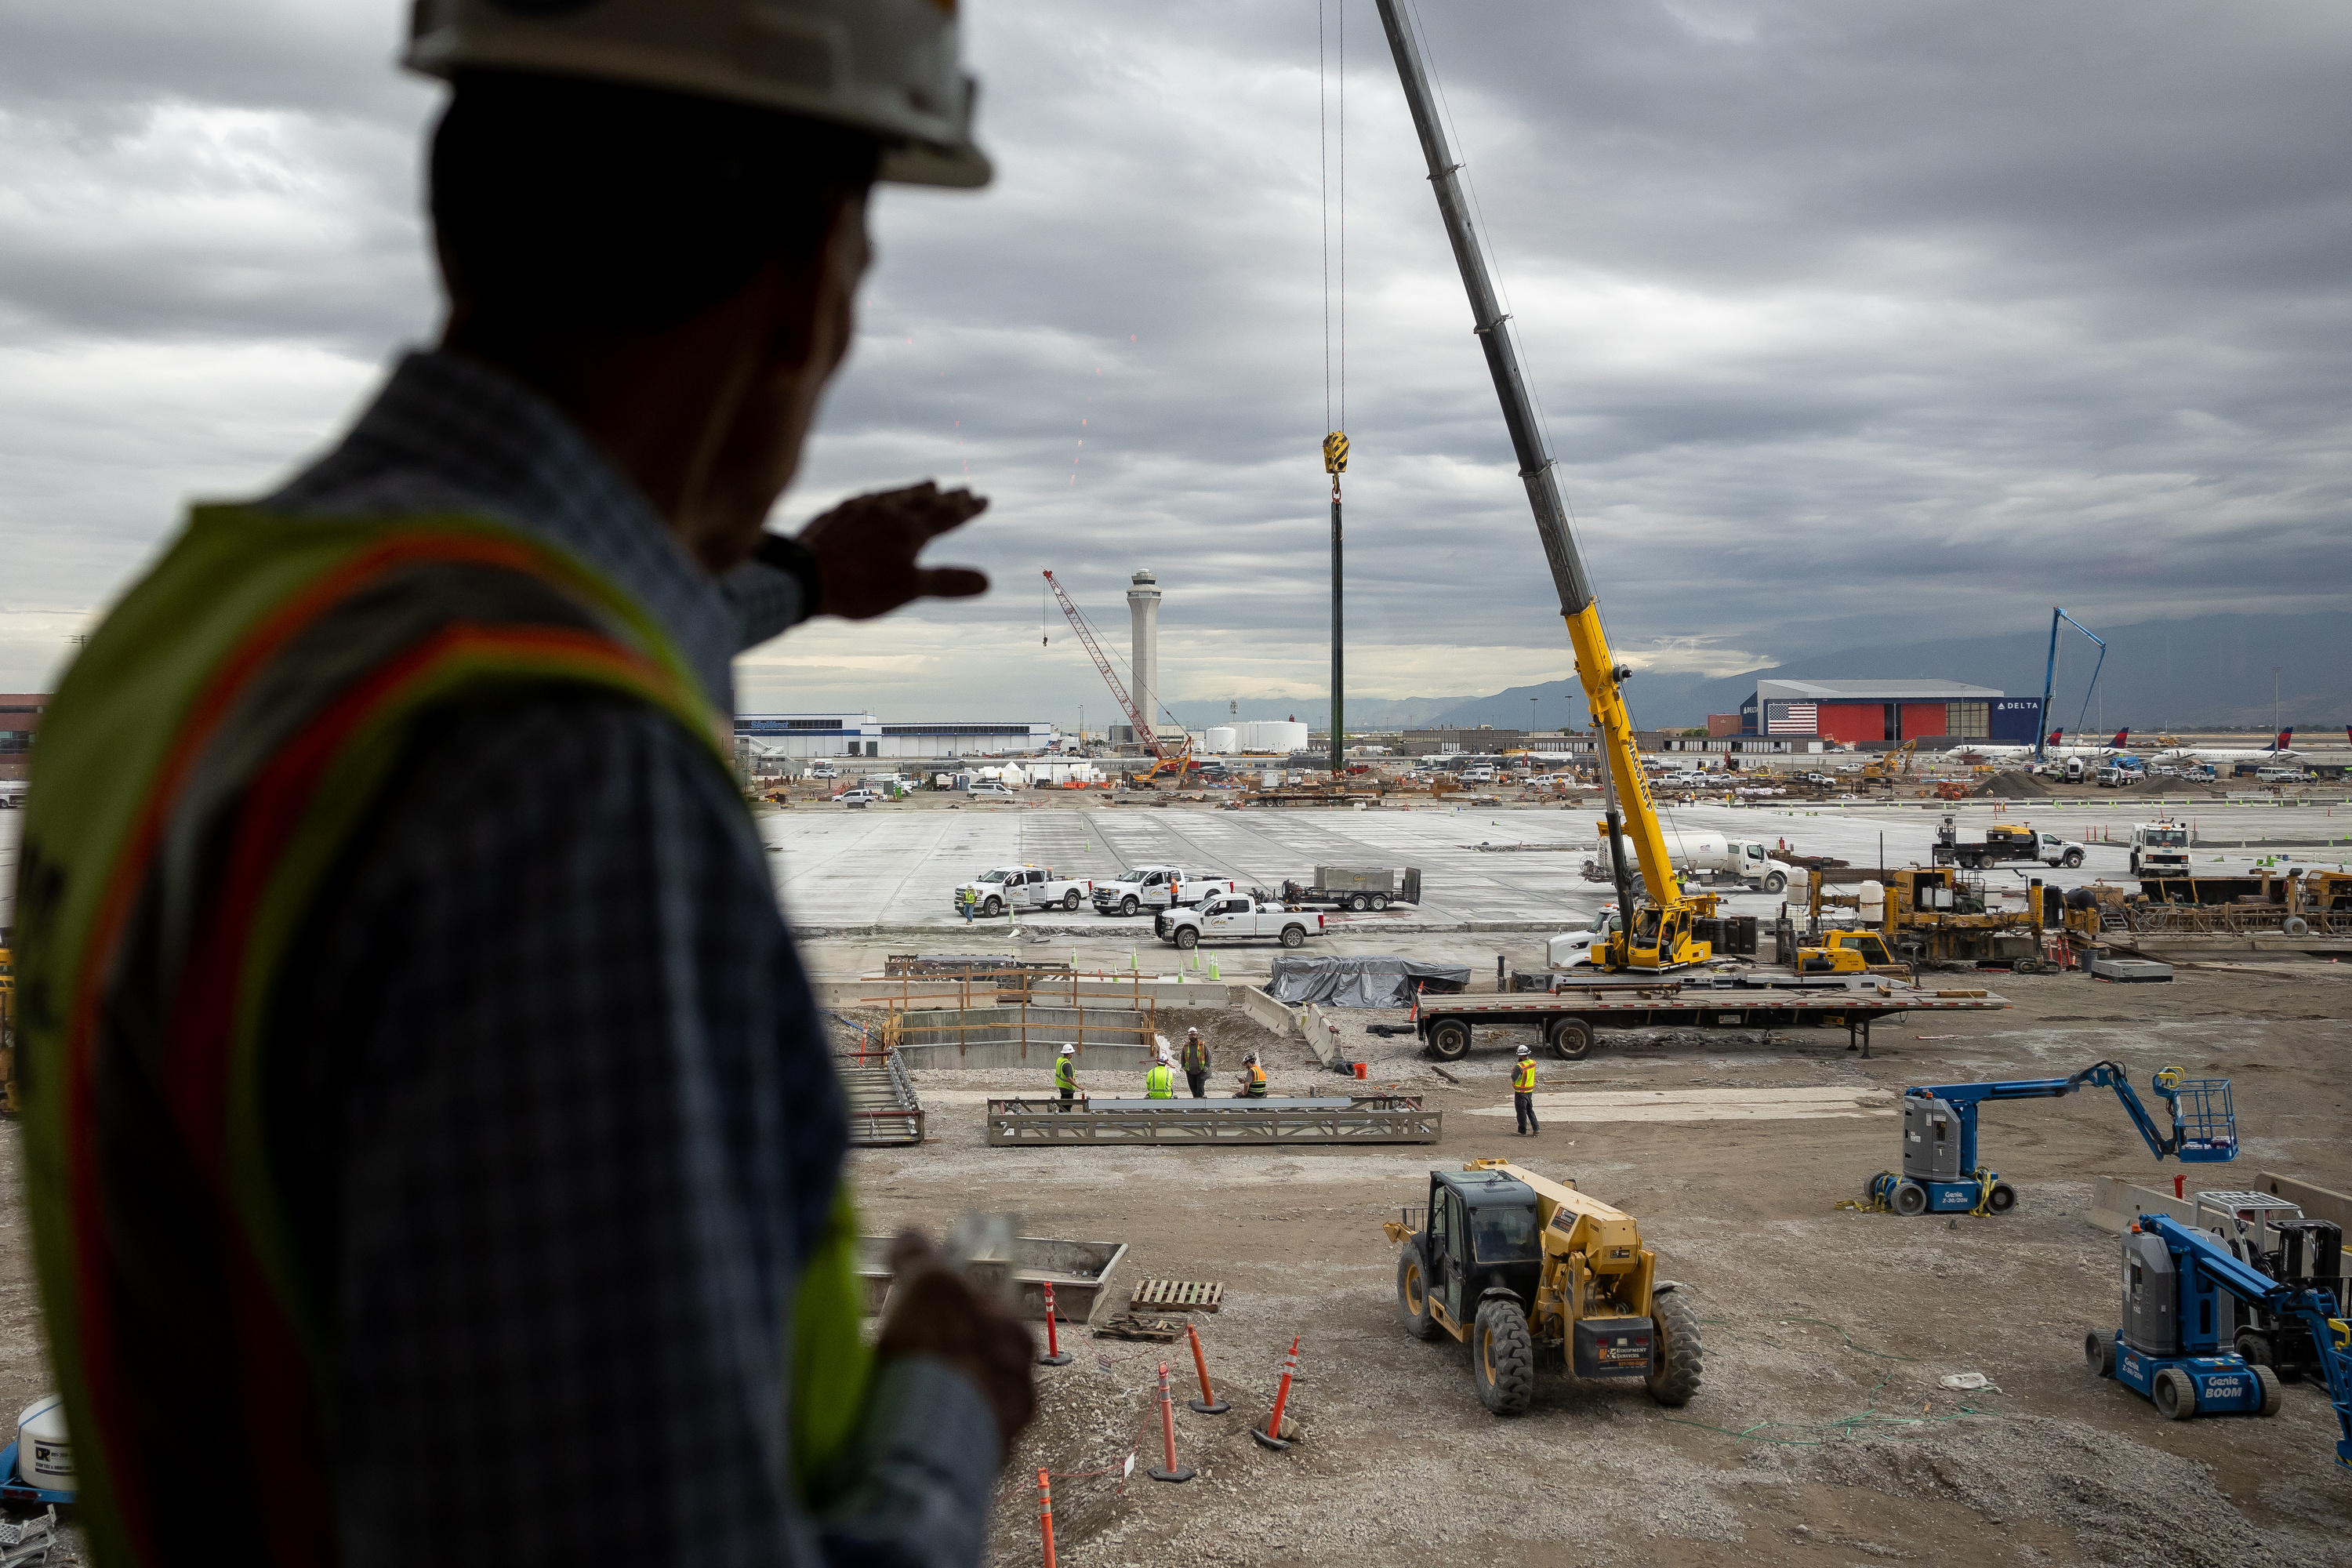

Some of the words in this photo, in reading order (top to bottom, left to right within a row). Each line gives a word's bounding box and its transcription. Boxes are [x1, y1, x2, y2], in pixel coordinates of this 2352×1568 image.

[750, 720, 789, 731] SkyWest
[1628, 737, 1653, 812] WAGSTAFF
[2124, 1357, 2140, 1371] Genie
[2208, 1376, 2239, 1387] Genie
[2205, 1387, 2243, 1399] BOOM
